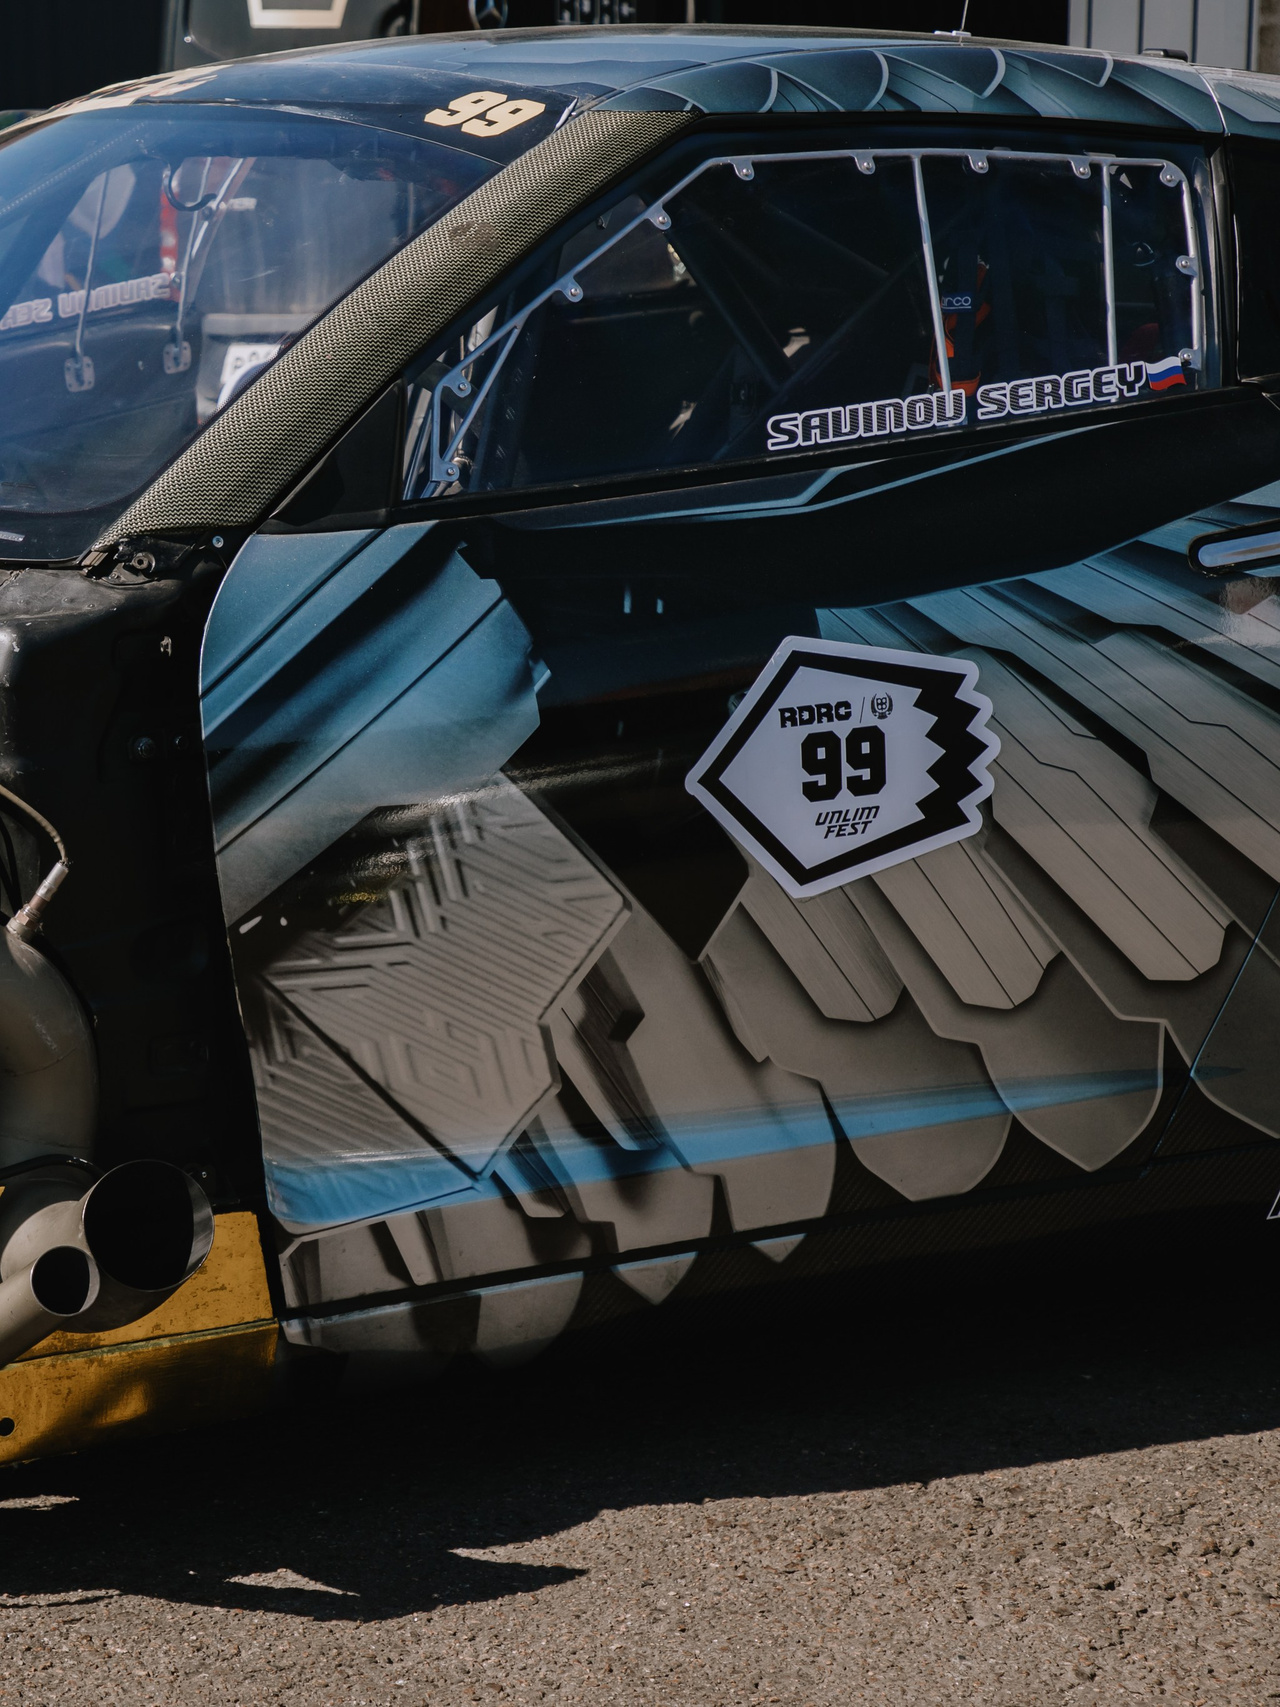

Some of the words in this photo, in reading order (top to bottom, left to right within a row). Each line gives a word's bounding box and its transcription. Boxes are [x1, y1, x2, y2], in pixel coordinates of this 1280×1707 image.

[424, 90, 546, 138] 99
[976, 361, 1148, 421] SERGEY
[779, 701, 852, 728] RDRC
[801, 726, 886, 802] 99
[815, 806, 880, 826] UNLIM
[824, 821, 873, 839] FEST
